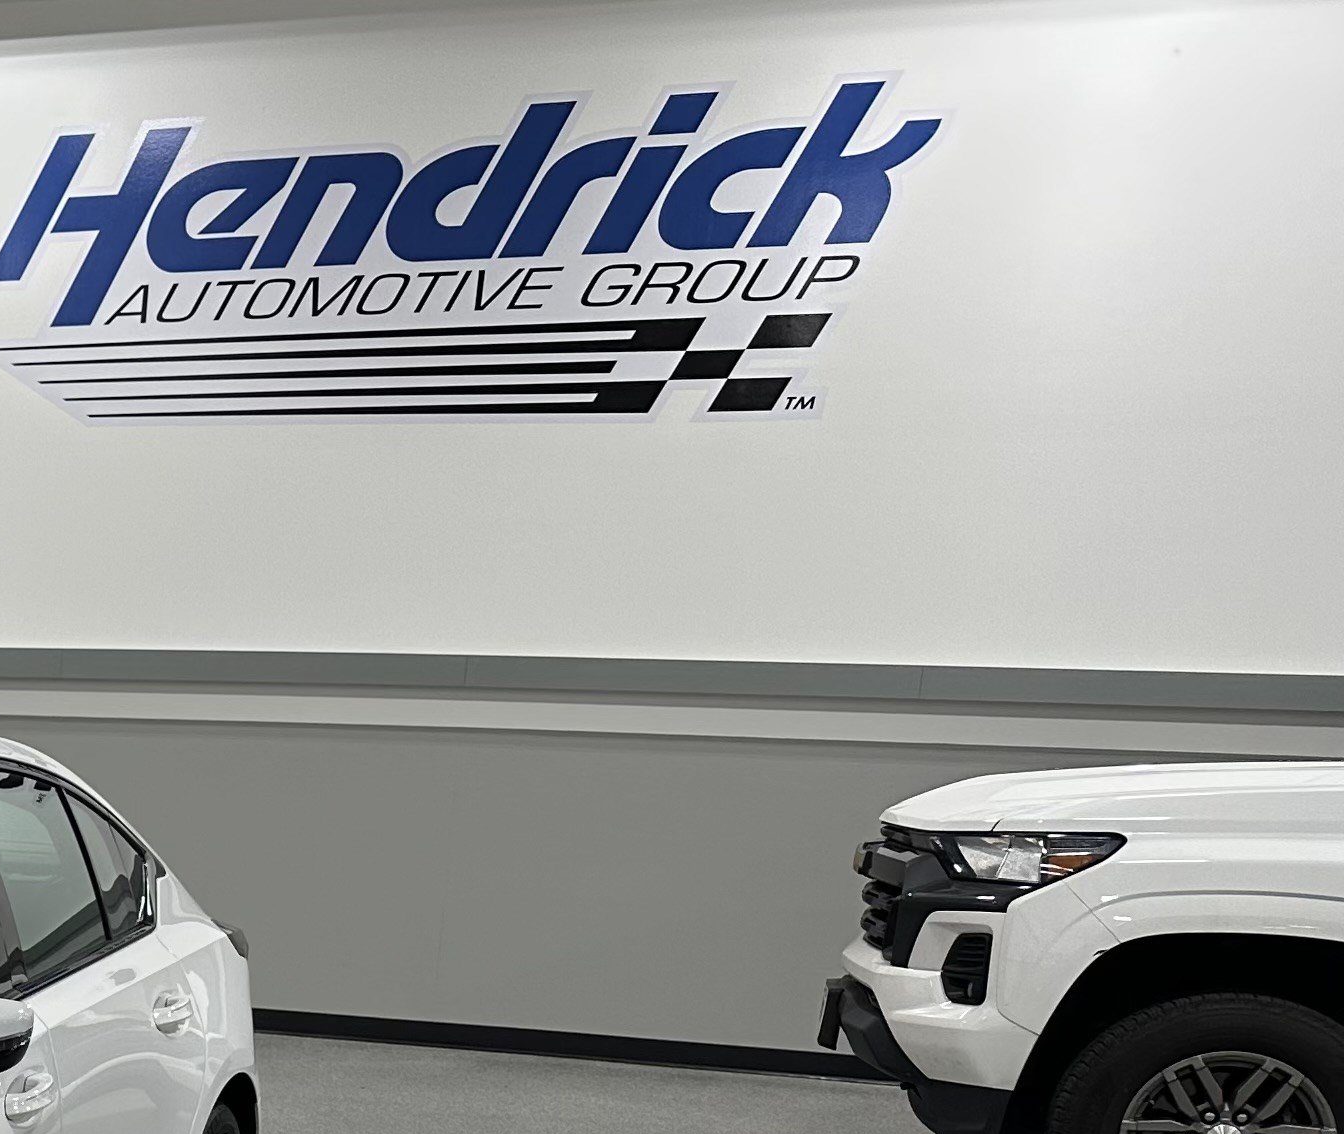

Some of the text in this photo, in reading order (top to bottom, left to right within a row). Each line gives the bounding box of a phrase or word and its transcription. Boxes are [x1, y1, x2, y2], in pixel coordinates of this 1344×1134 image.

[104, 255, 861, 326] AUTOMOTIVE GROUP
[784, 396, 816, 410] TM
